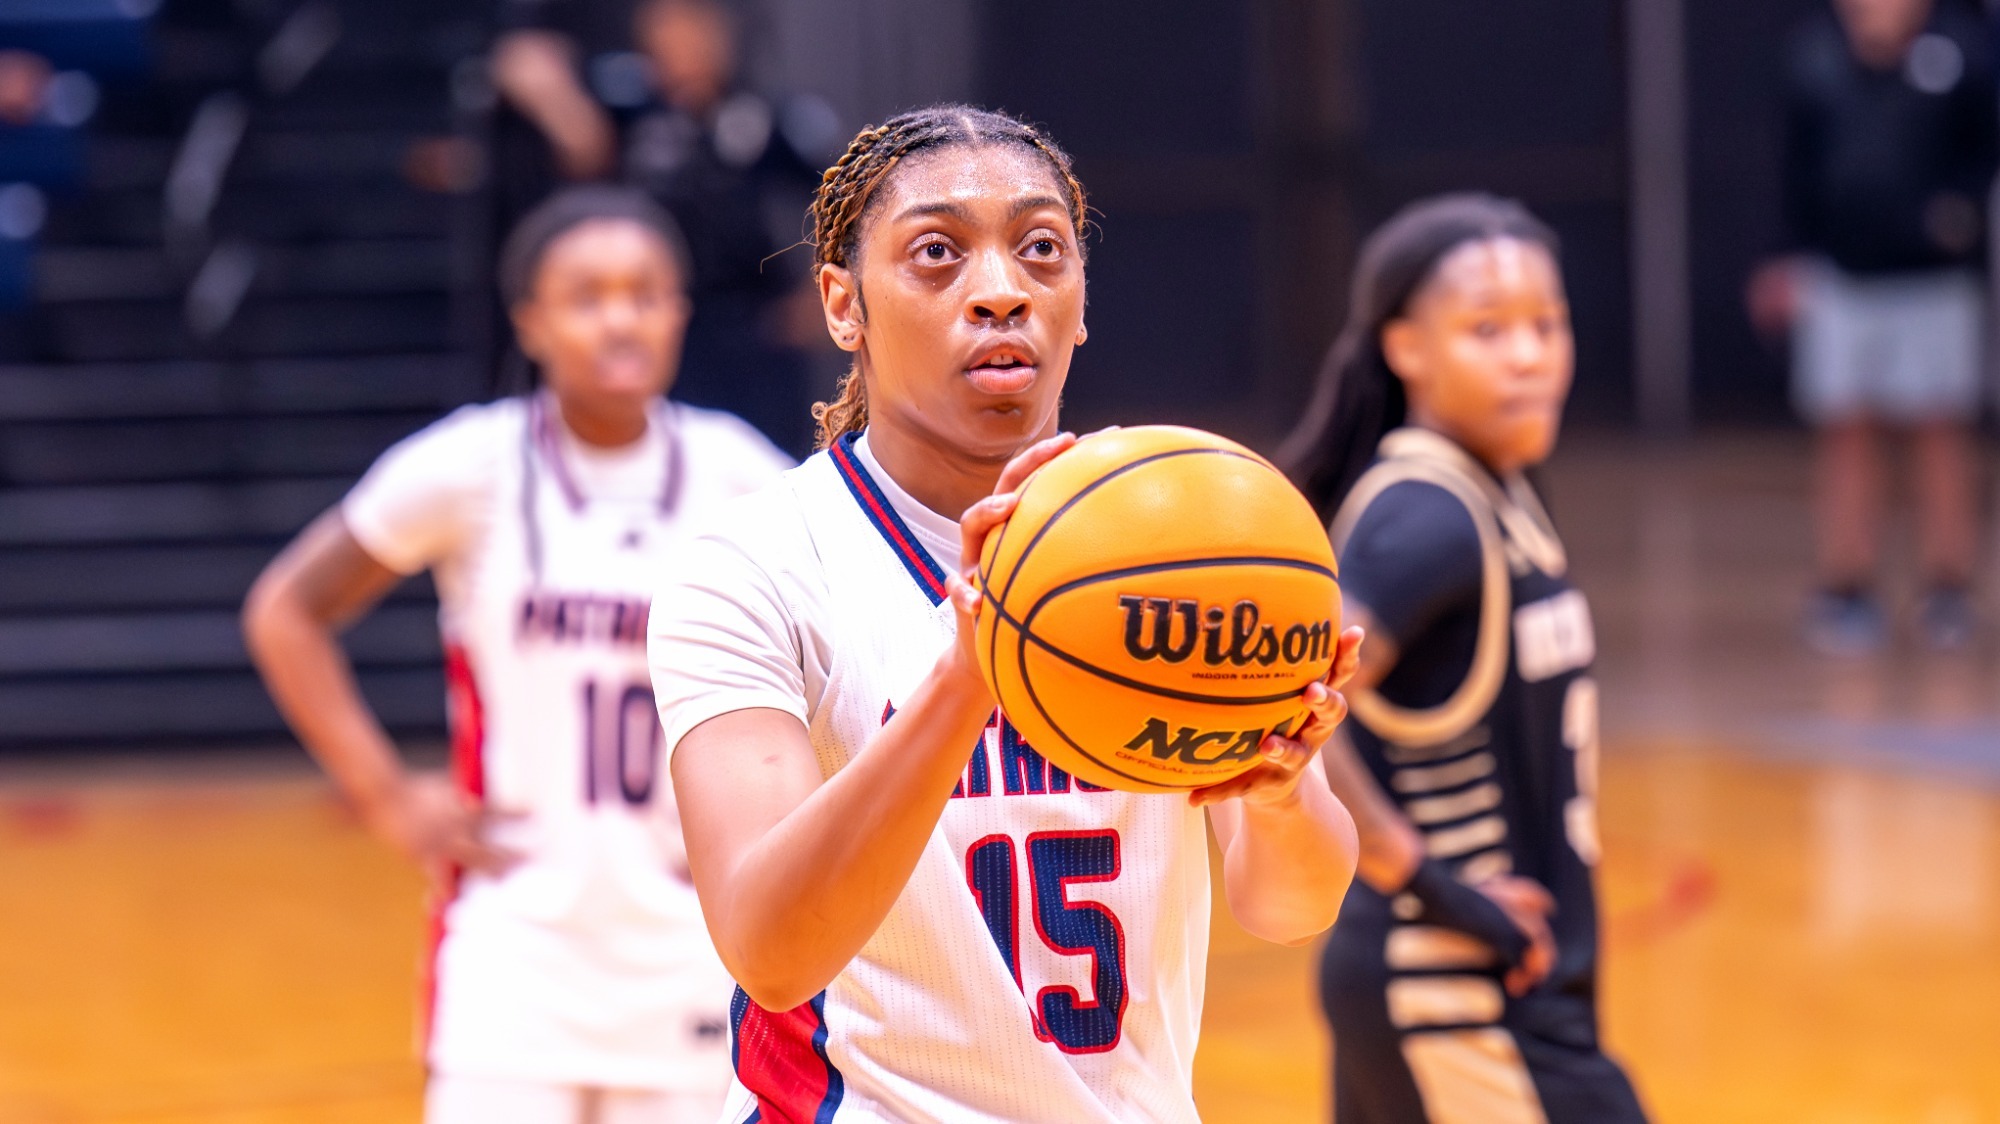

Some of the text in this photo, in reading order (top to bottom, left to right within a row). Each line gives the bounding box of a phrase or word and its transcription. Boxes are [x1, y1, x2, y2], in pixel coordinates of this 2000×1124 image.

[1119, 594, 1331, 667] Wilson
[1191, 671, 1238, 680] INDOOR
[1241, 672, 1271, 680] GAME
[582, 678, 664, 808] 10
[965, 828, 1129, 1056] 15
